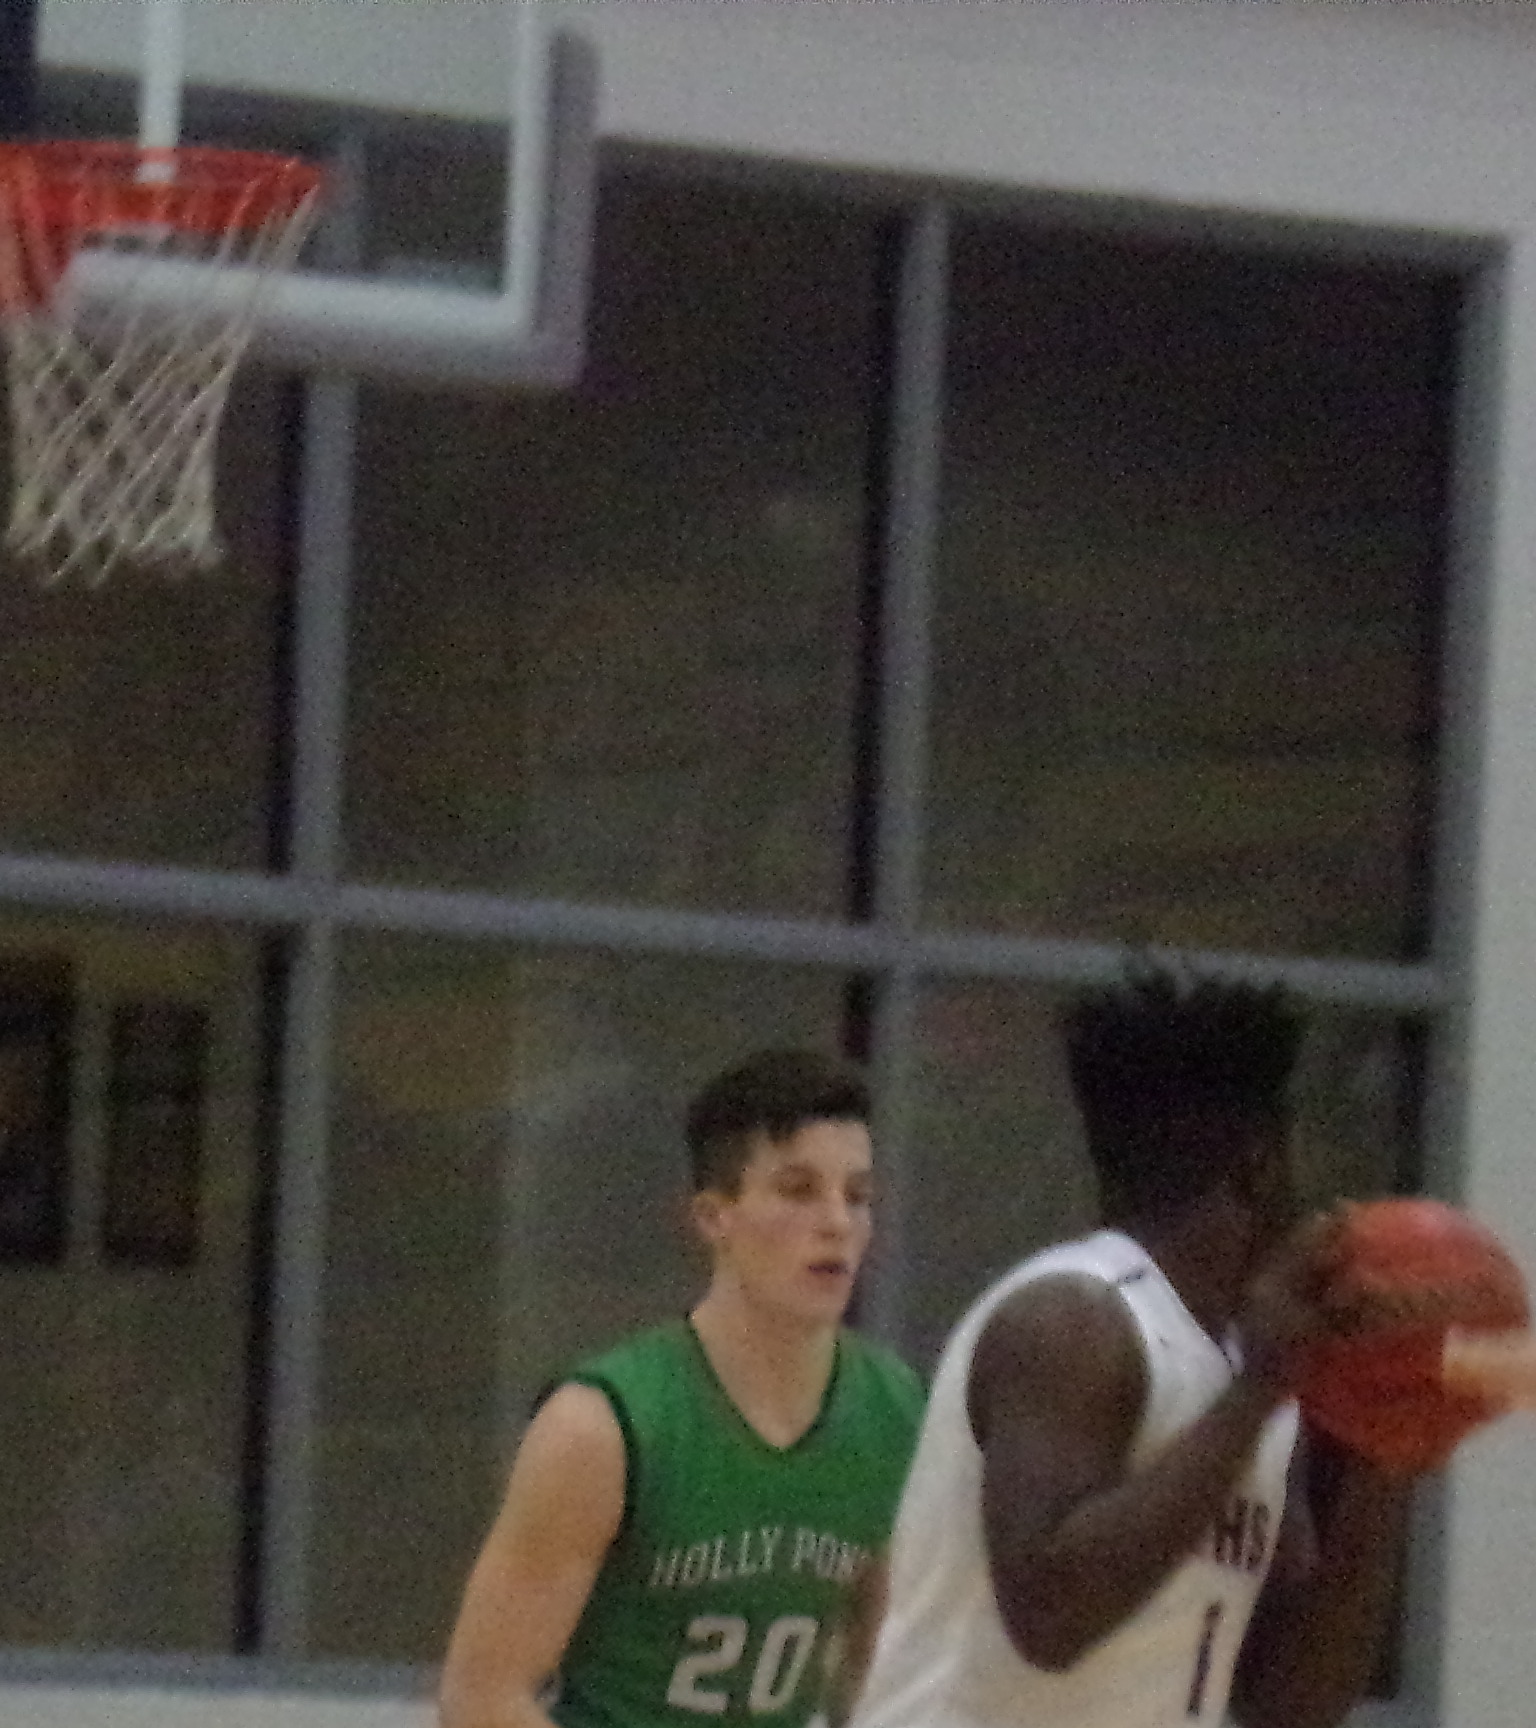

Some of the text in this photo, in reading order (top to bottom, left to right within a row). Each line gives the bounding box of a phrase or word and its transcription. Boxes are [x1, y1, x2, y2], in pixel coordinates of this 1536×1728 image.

[648, 1524, 785, 1589] HOLLY
[666, 1612, 821, 1714] 20
[1186, 1602, 1224, 1717] 1
